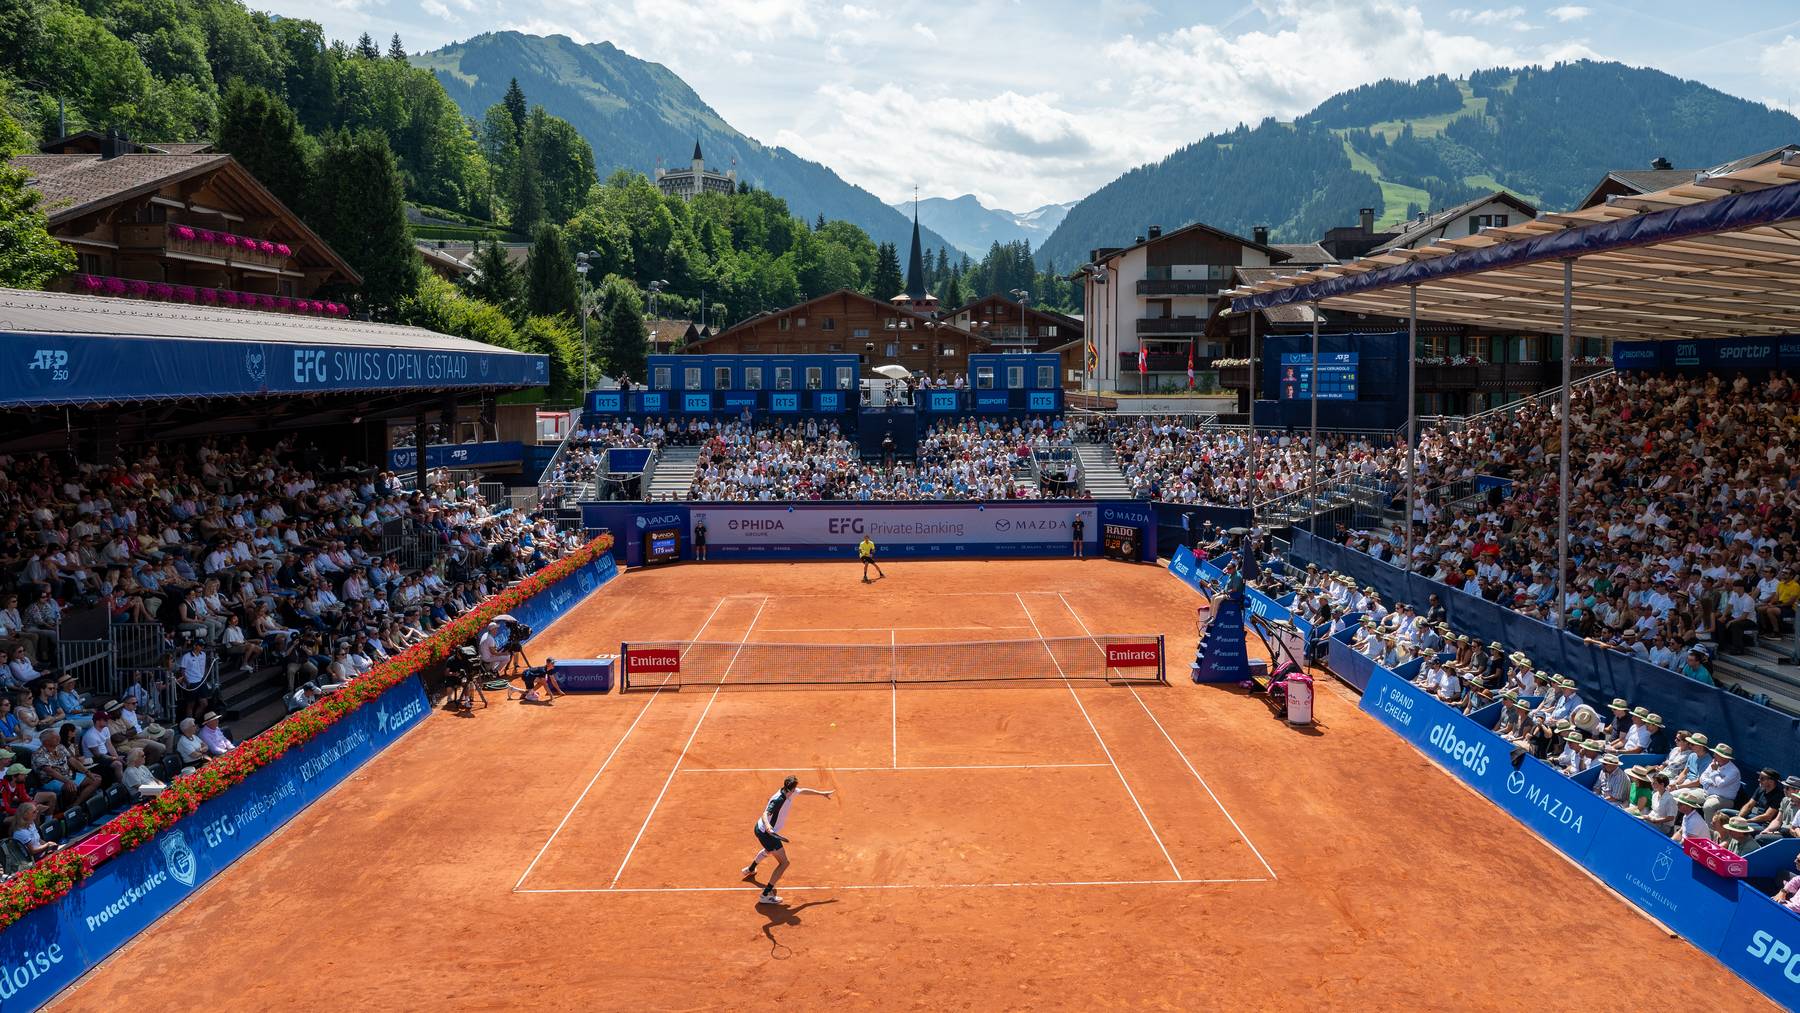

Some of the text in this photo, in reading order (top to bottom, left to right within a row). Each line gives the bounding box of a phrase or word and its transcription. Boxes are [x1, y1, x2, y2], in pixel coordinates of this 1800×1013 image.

[28, 350, 69, 370] ATP
[293, 350, 468, 383] EFG SWISS OPEN GSTAAD
[52, 370, 69, 381] 250
[599, 398, 618, 407] RTS
[688, 398, 707, 407] RTS
[775, 398, 794, 407] RTS
[934, 397, 953, 406] RTS
[1032, 397, 1052, 406] RTS
[647, 514, 681, 525] VANDA
[1116, 511, 1149, 523] MAZDA
[741, 519, 785, 530] PHIDA
[828, 517, 965, 537] EFG Private Banking
[1015, 520, 1067, 530] MAZDA
[1106, 525, 1134, 538] RADO
[630, 655, 677, 667] Emirates
[1109, 650, 1156, 661] Emirates
[1390, 688, 1414, 710] GRAND
[390, 698, 424, 731] CELESTE
[1384, 701, 1412, 728] CHELEM
[1429, 722, 1490, 777] albedis
[202, 779, 297, 848] EFG Private Banking
[1525, 784, 1584, 834] MAZDA
[1625, 872, 1679, 912] LE GRAND BELLEVUE
